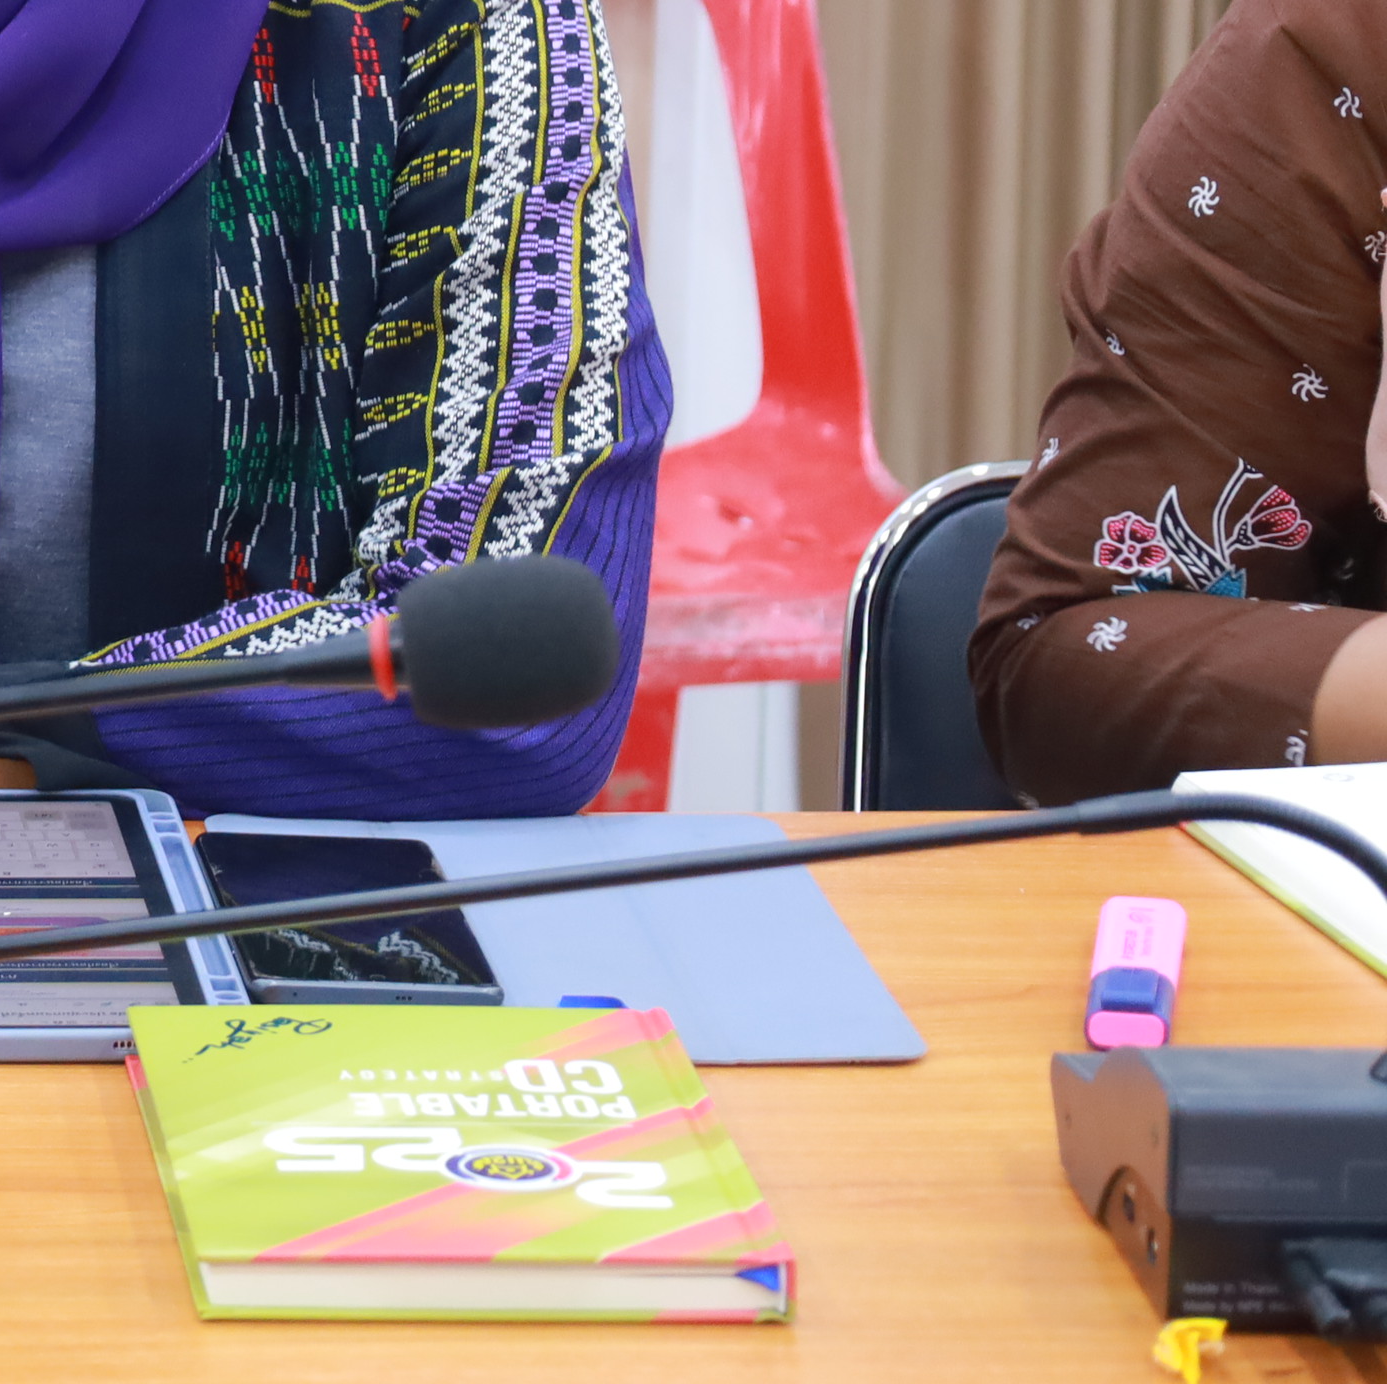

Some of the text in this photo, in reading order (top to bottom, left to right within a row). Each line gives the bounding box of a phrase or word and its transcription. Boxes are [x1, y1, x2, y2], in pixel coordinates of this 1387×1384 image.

[338, 1059, 624, 1094] CD STRATEGY
[354, 1092, 637, 1120] PORTABLE
